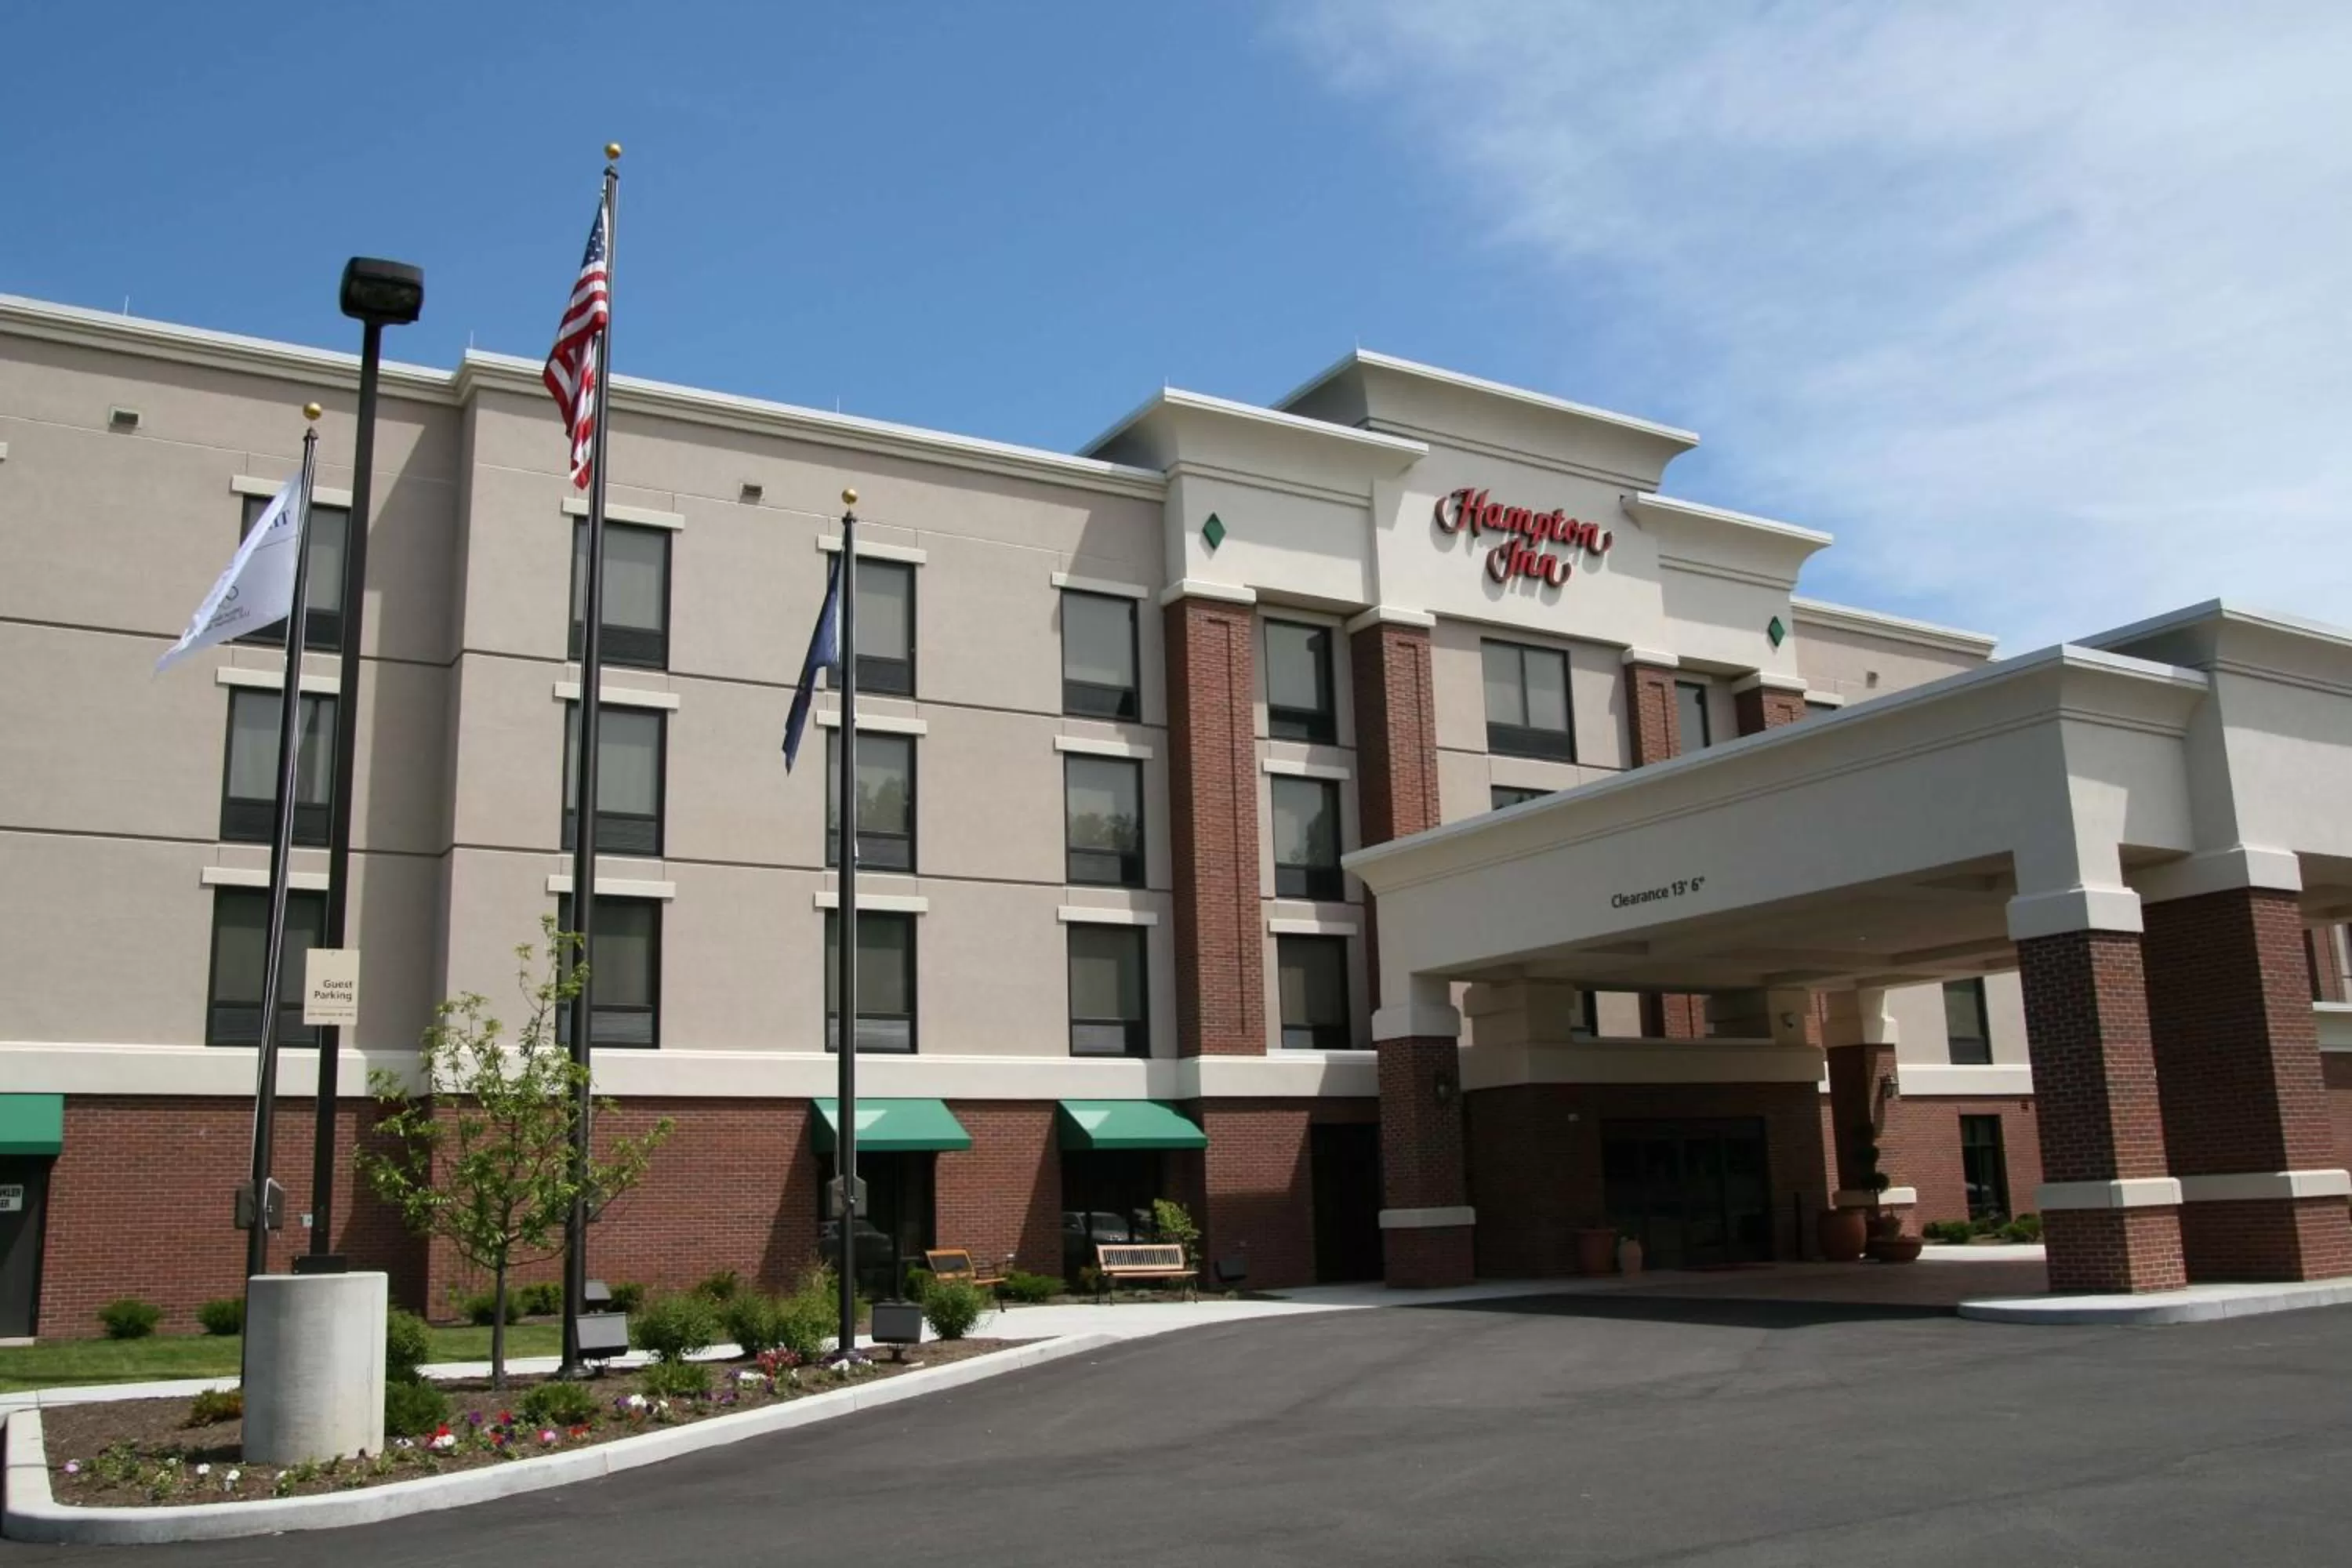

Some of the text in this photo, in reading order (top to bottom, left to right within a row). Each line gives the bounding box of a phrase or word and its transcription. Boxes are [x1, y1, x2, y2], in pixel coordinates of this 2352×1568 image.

[1435, 488, 1613, 556] Hampton
[1486, 538, 1572, 587] Inn
[1611, 888, 1669, 908] Clearance
[1671, 880, 1688, 896] 13'
[314, 990, 352, 1002] Parking
[323, 979, 352, 989] Guest
